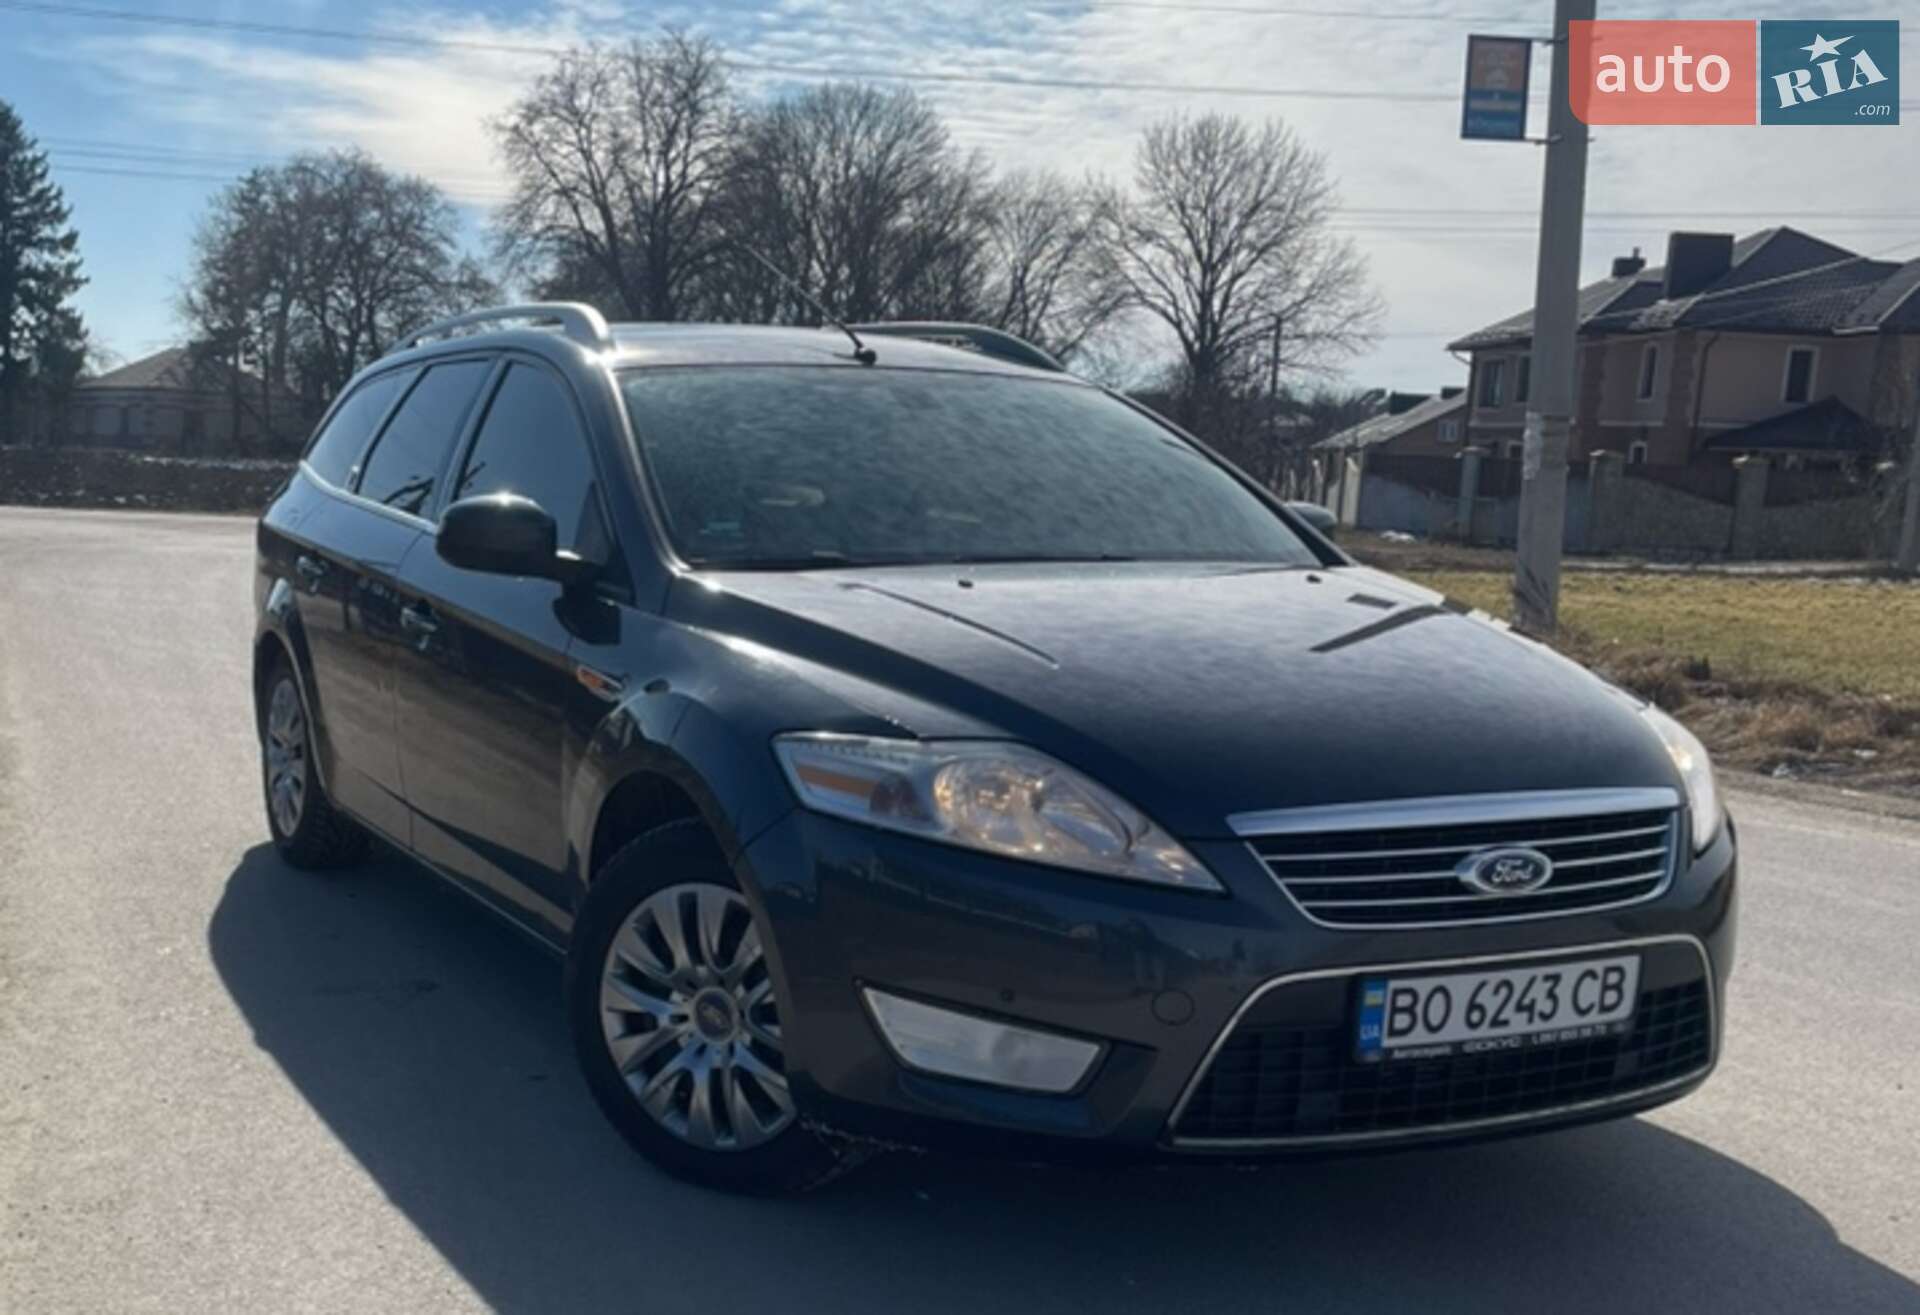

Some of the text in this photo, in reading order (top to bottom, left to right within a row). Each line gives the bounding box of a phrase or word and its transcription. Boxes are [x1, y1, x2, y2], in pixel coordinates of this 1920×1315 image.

[1491, 859, 1536, 882] Ford
[1386, 965, 1627, 1038] BO 6243 CB
